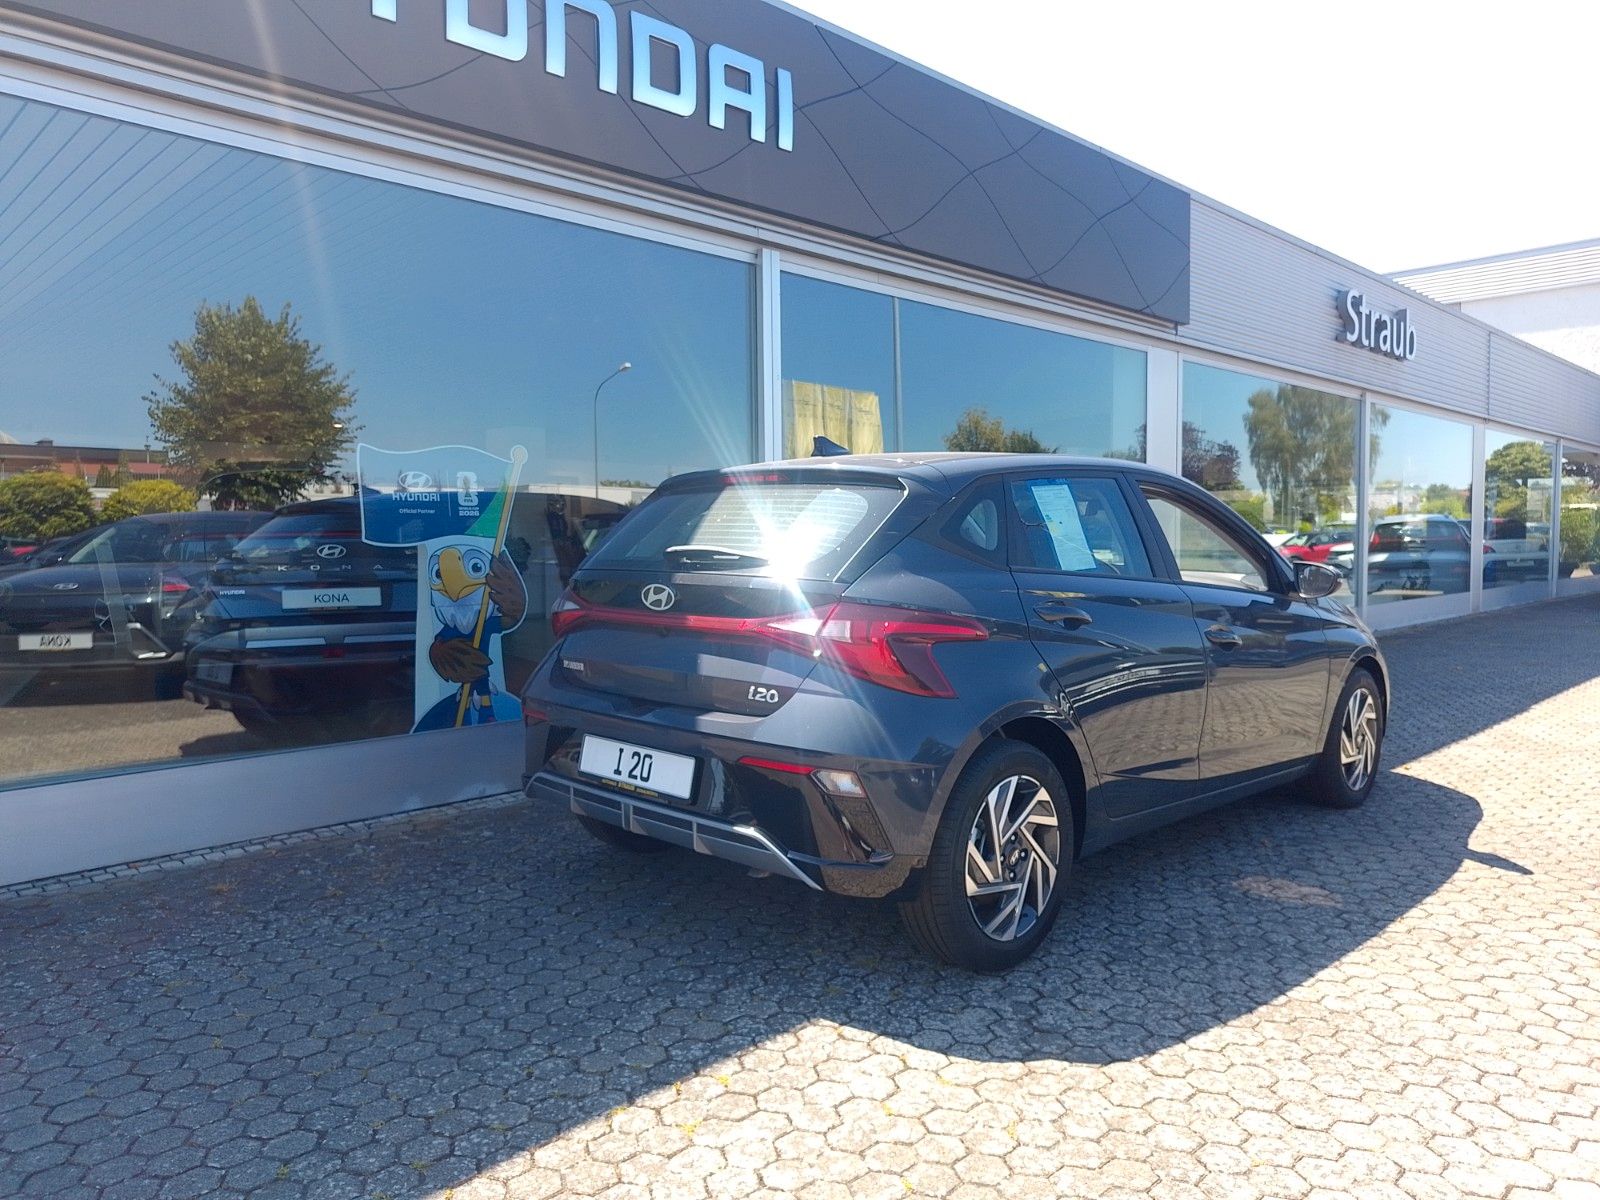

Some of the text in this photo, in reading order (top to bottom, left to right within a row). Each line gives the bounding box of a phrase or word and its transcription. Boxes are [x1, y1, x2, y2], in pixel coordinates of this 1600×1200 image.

[372, 0, 793, 152] UNDAI
[1346, 288, 1417, 361] Straub
[392, 492, 440, 501] HYUNDAI
[314, 593, 350, 604] KONA
[748, 685, 779, 703] i20
[628, 751, 653, 783] 20
